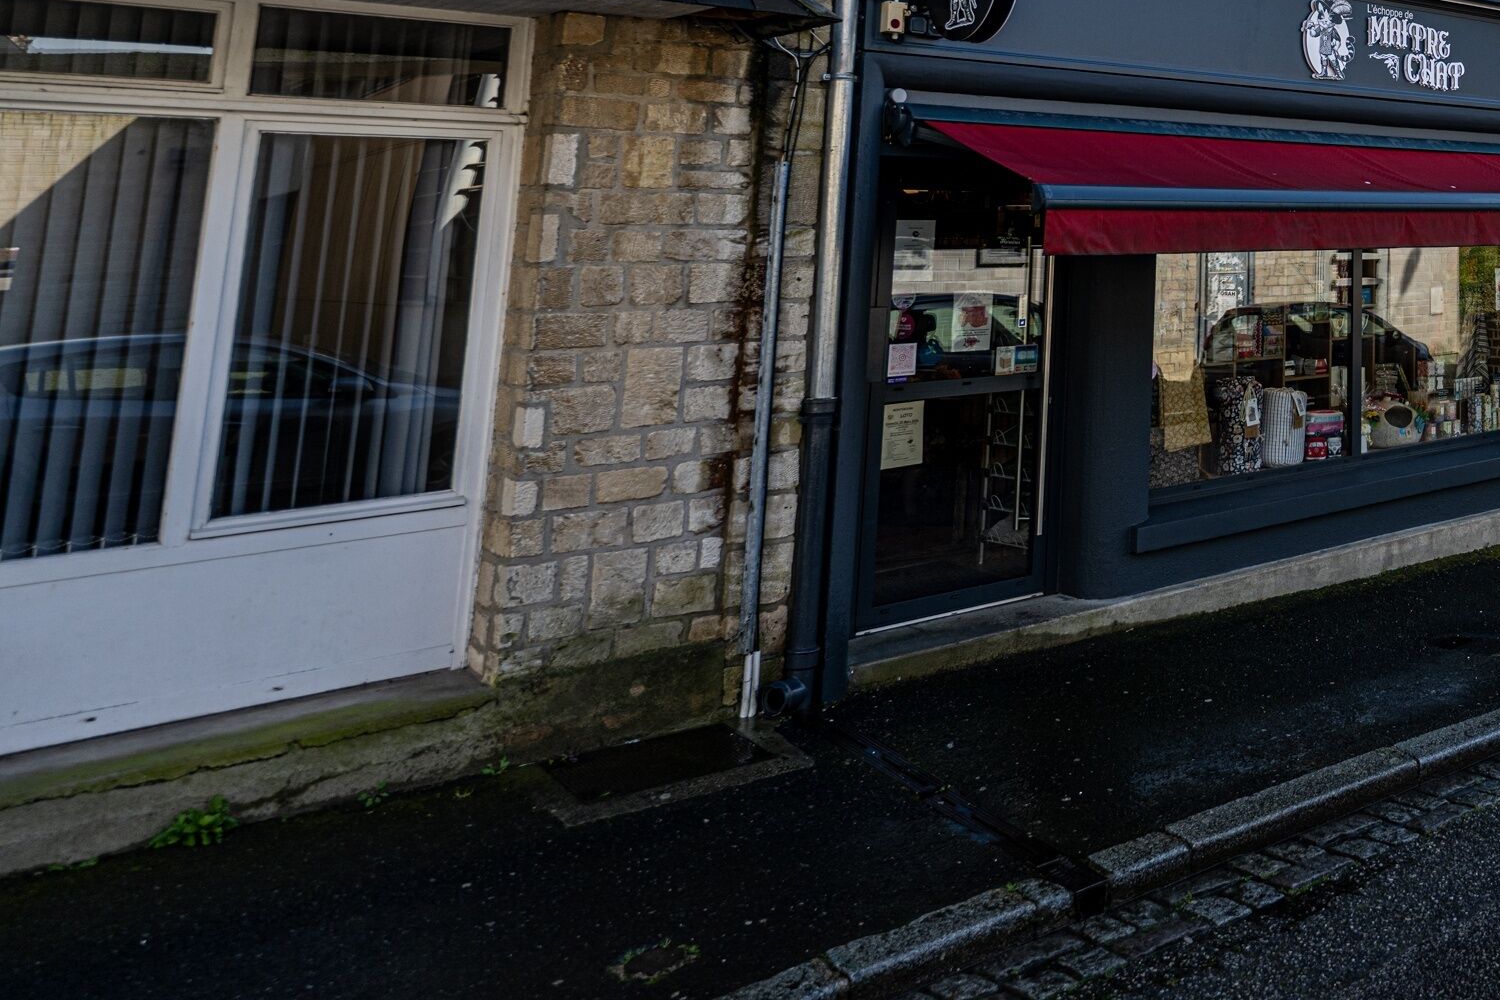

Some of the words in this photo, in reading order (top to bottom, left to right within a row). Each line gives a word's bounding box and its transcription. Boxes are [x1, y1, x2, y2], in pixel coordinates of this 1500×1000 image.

[1367, 3, 1403, 18] L'échoppe
[1404, 10, 1414, 20] de
[1404, 53, 1465, 92] CHAT
